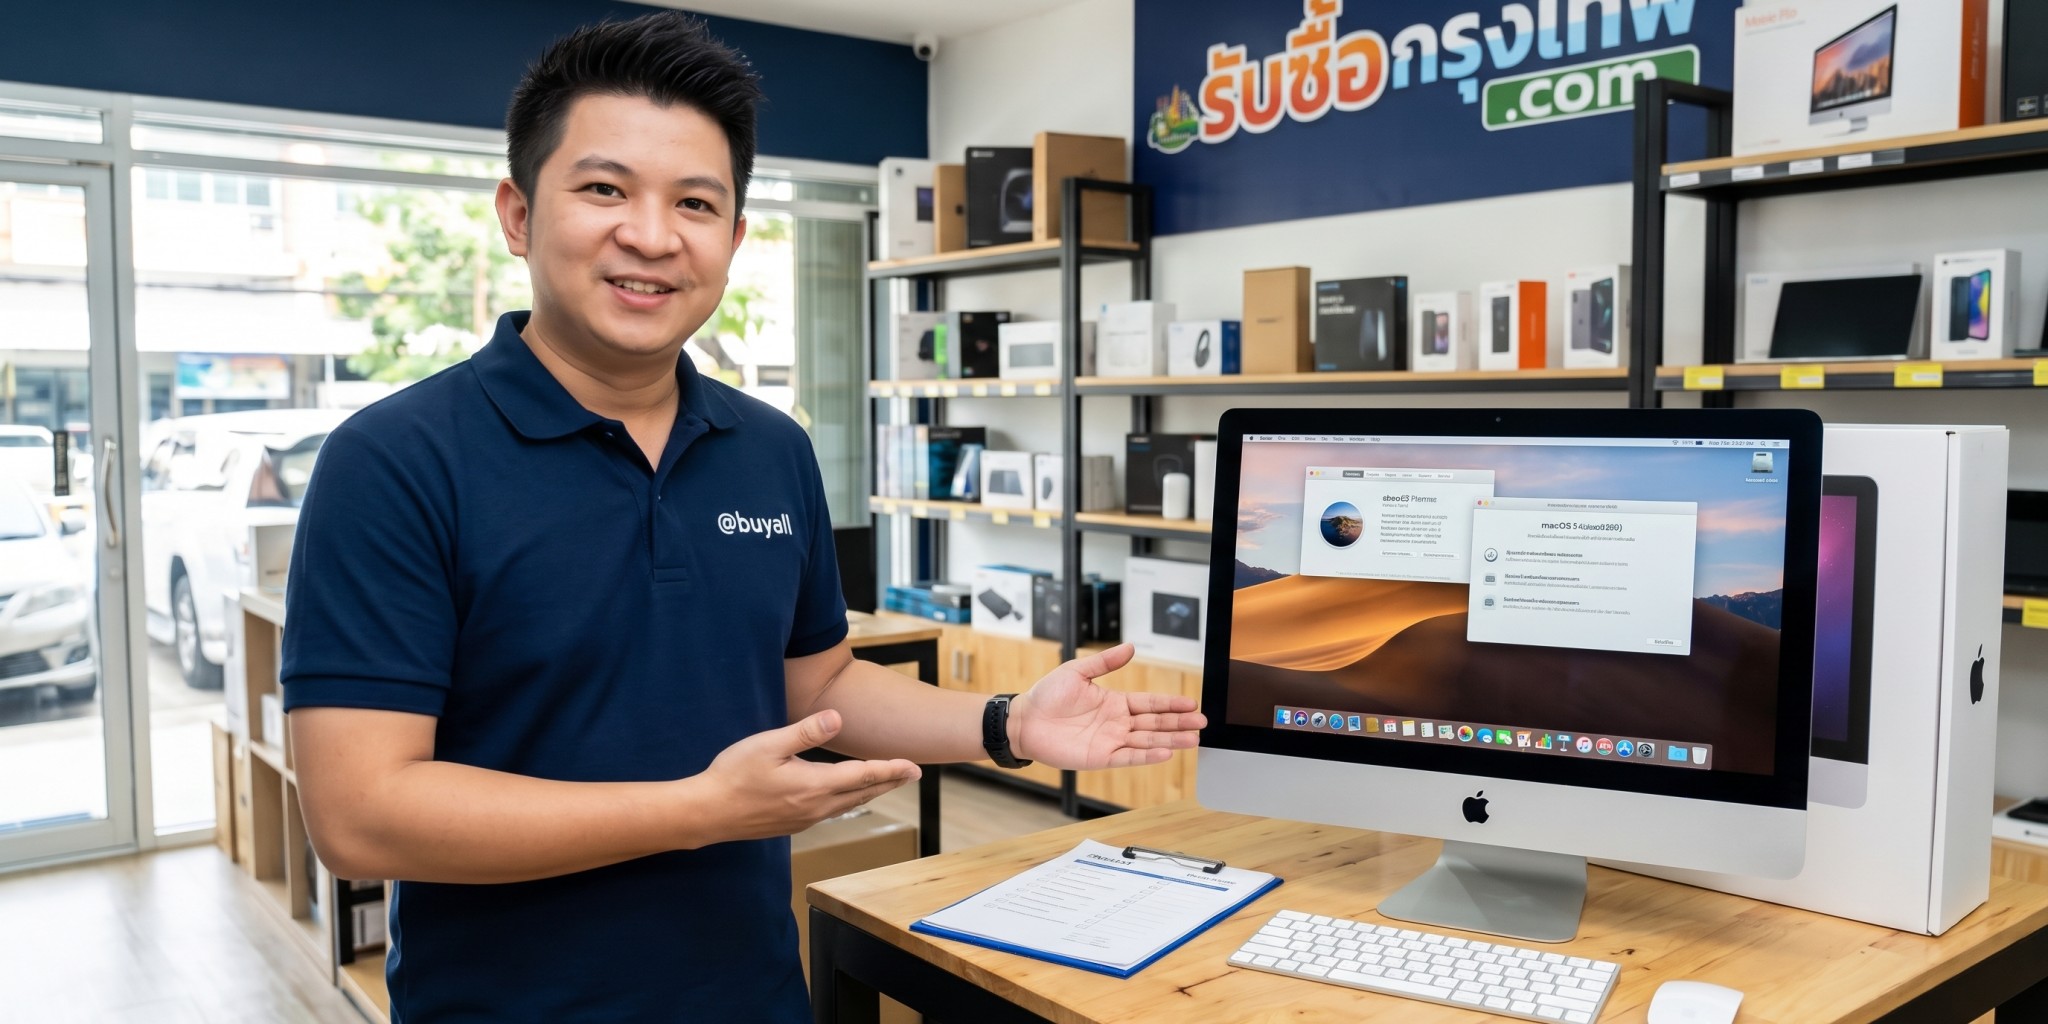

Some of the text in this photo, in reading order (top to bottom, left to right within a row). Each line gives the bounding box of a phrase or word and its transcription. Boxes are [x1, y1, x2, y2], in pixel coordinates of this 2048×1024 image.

[1505, 59, 1658, 122] .com
[717, 510, 793, 539] @buyall
[1541, 522, 1572, 530] macOS
